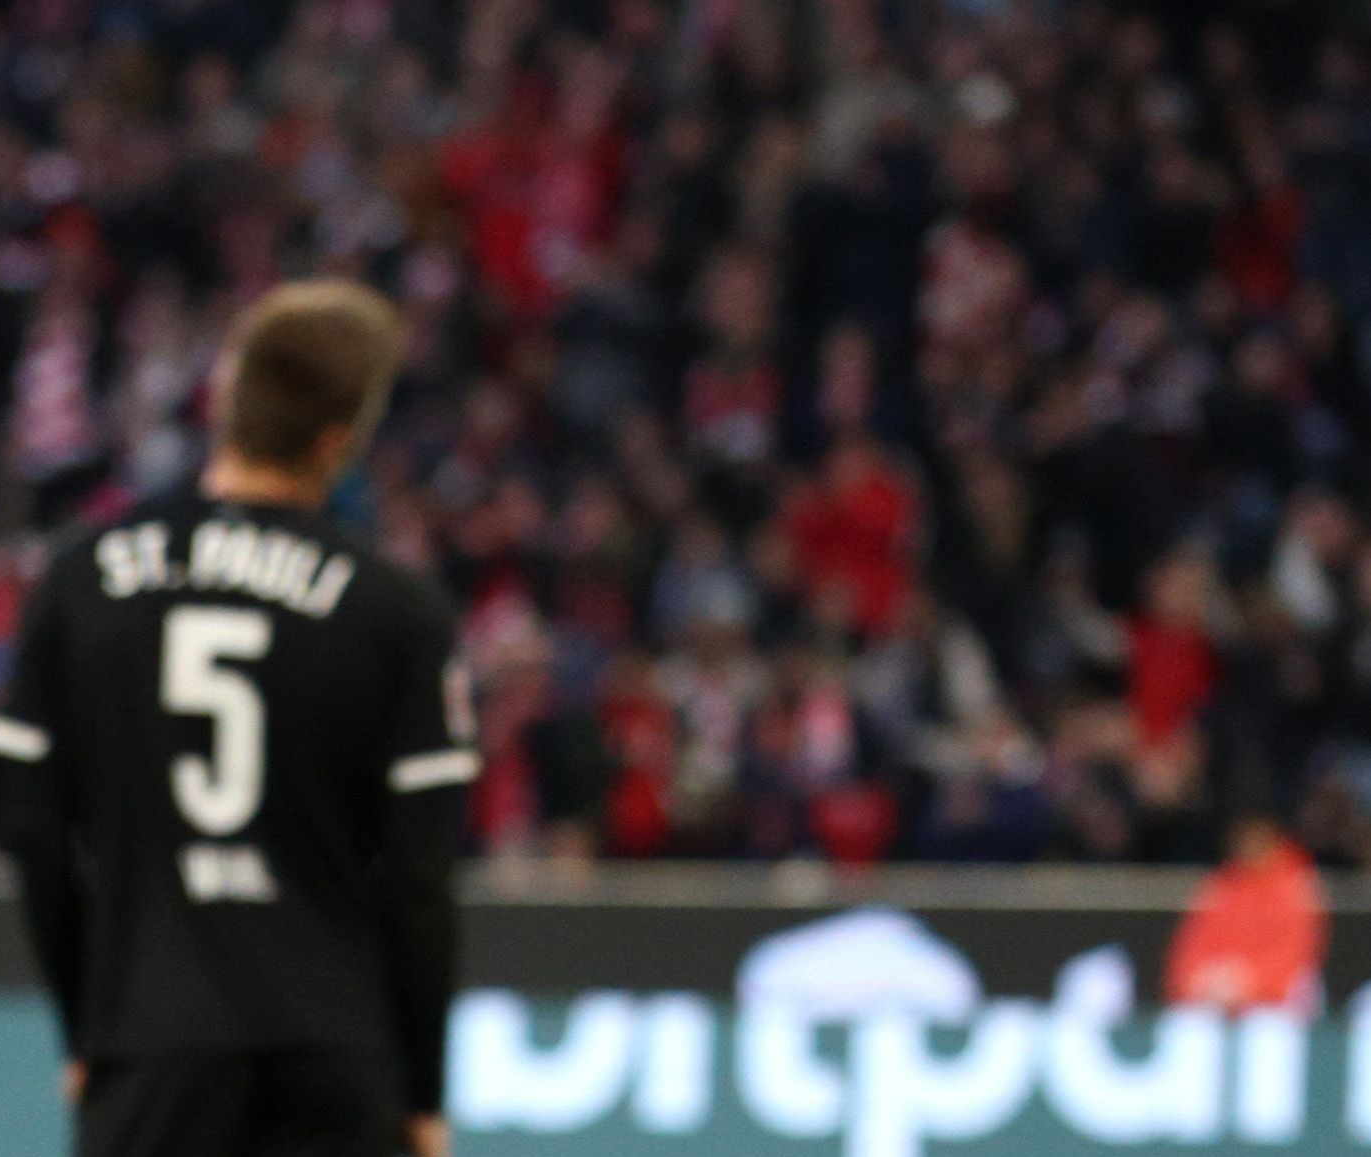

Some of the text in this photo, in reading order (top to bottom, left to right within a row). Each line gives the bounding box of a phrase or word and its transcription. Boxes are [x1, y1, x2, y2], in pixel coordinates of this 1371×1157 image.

[95, 520, 356, 617] ST. PAULI
[160, 607, 271, 835] 5
